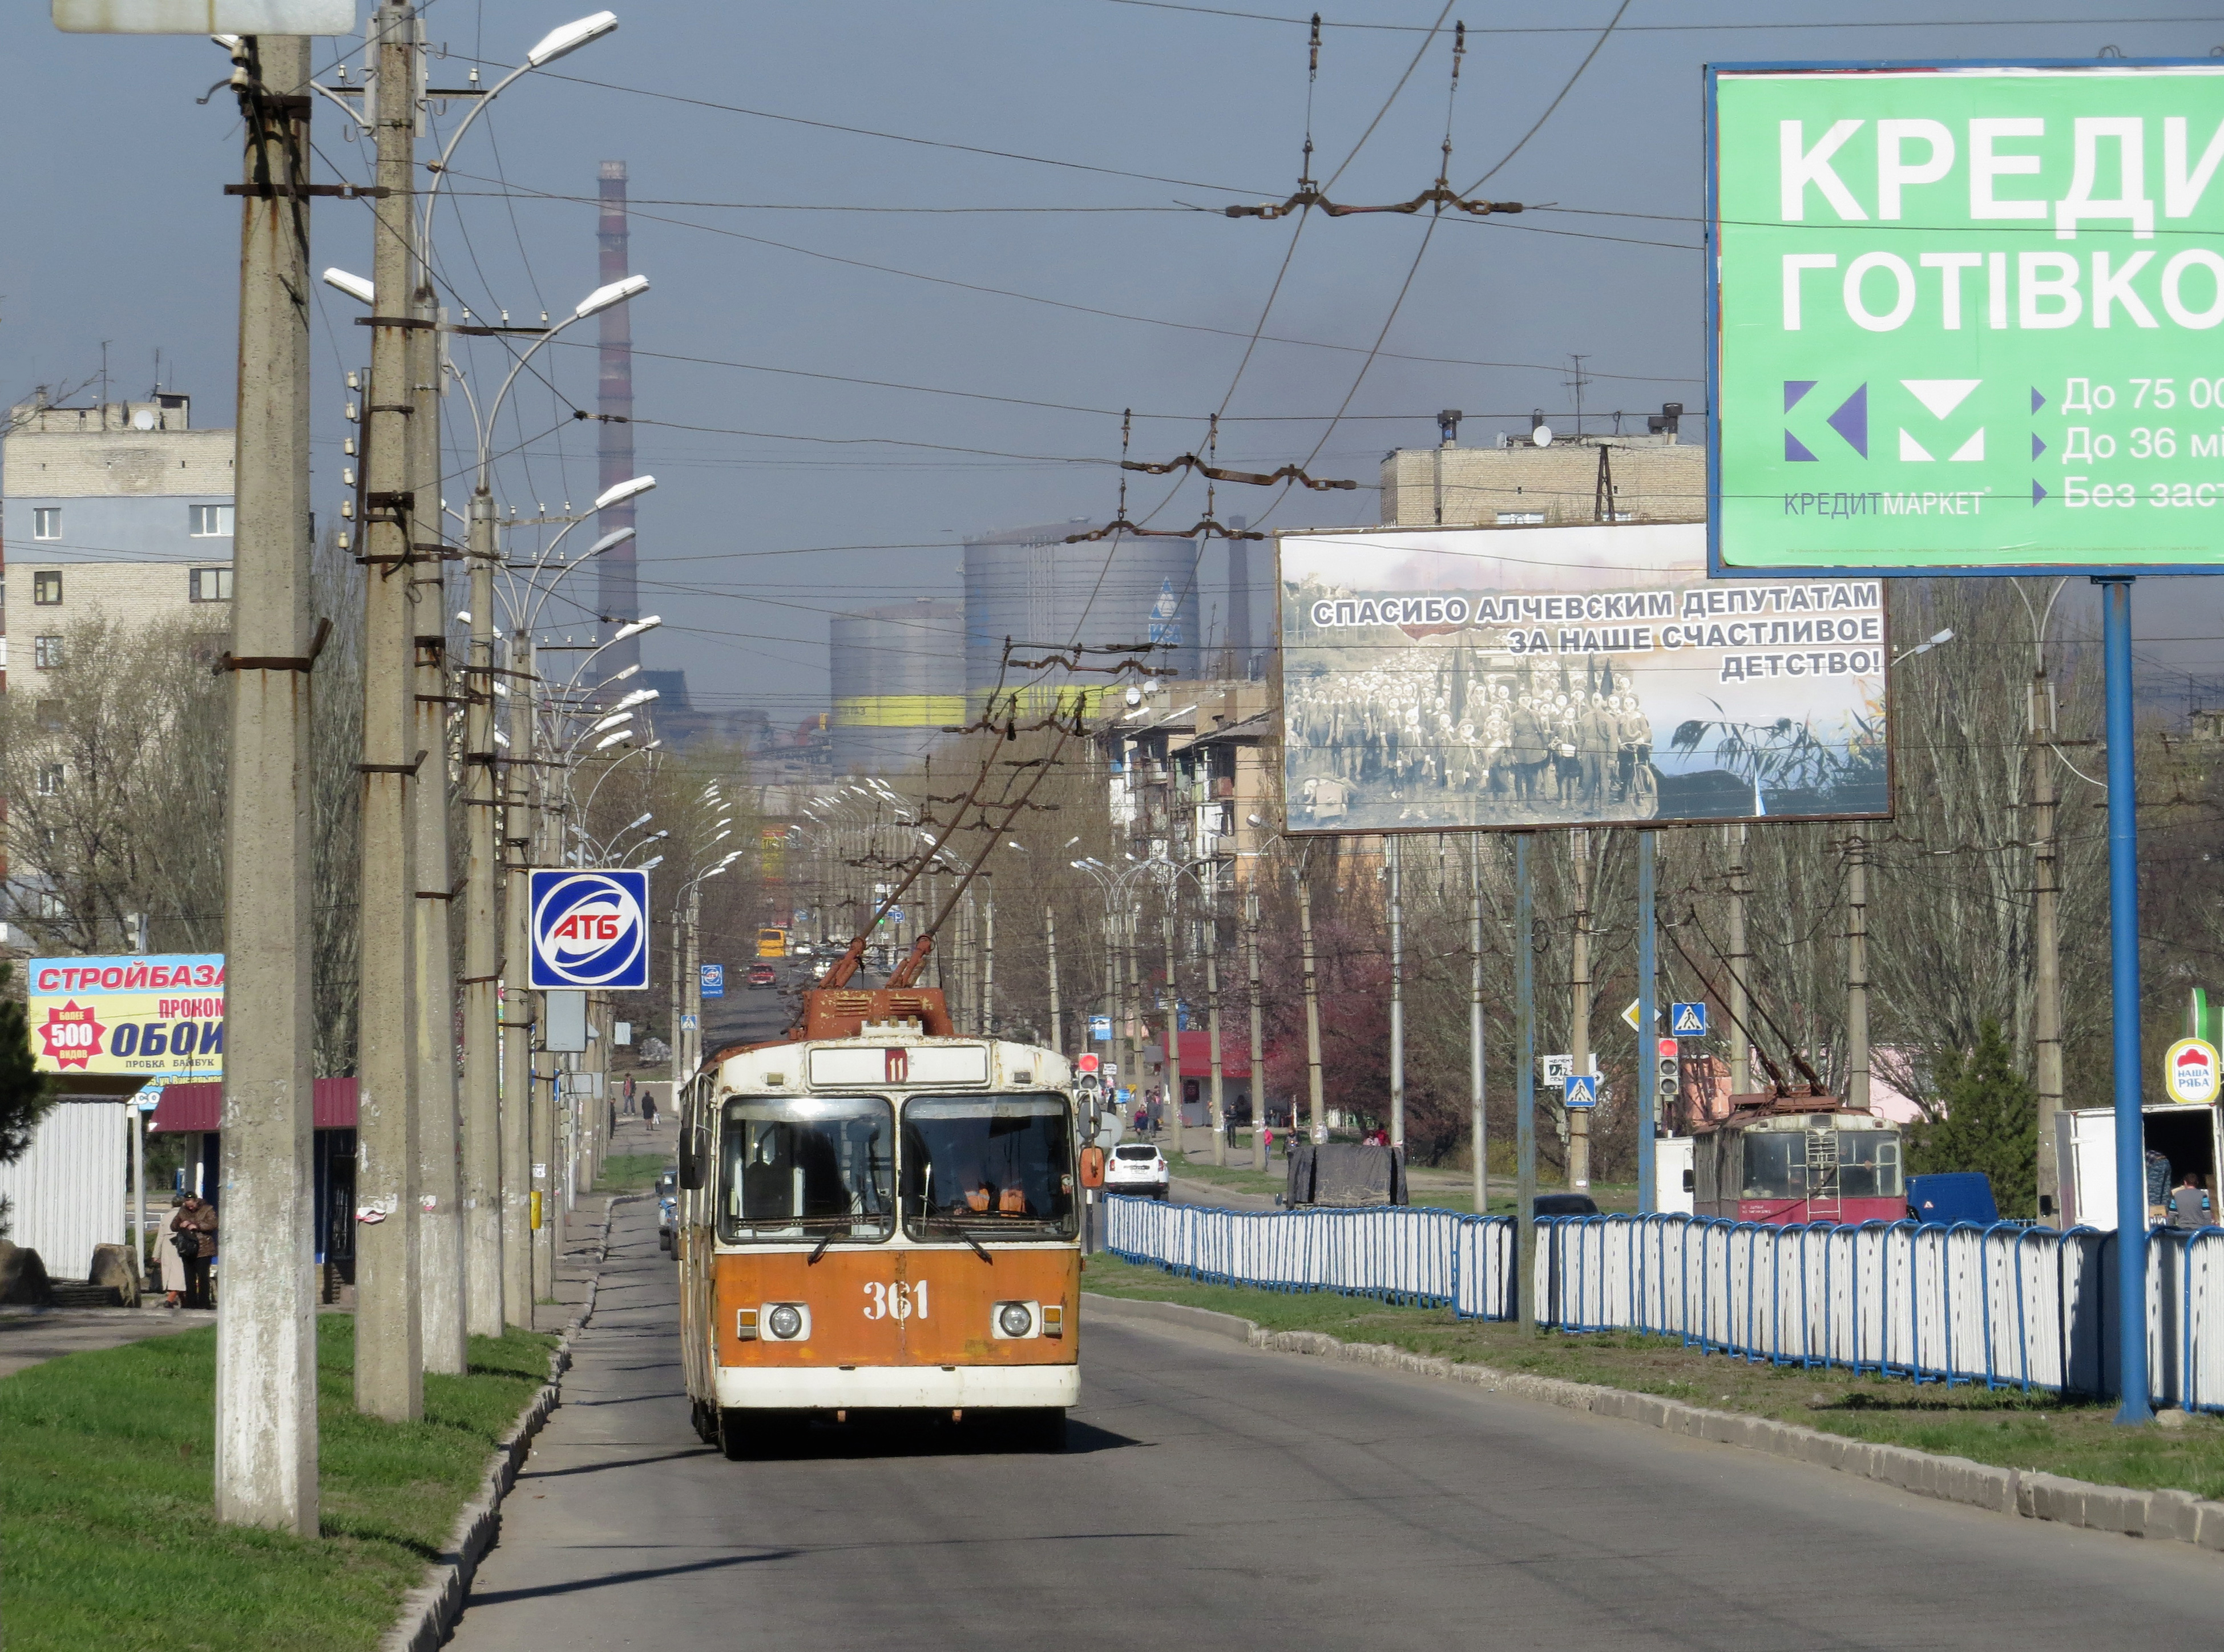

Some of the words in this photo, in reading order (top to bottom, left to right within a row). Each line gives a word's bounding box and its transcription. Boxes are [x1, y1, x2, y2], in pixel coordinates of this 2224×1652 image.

[1779, 116, 2224, 240] КРЕДИ
[1782, 248, 2224, 332] ГОТІВКО
[2061, 377, 2116, 415] До
[2129, 378, 2176, 410] 75
[2061, 427, 2116, 465] До
[2130, 427, 2177, 459] 36
[1784, 491, 1985, 520] КРЕДИТМАРКЕТ
[2064, 476, 2137, 508] Без
[1312, 598, 1468, 625] СПАСИБО
[1477, 594, 1672, 621] АЛЧЕВСКИМ
[1682, 584, 1878, 618] ДЕПУТАТАМ
[1508, 630, 1549, 654] ЗА
[1560, 628, 1652, 652] НАШЕ
[1662, 617, 1879, 648] СЧАСТЛИВОЕ
[1721, 650, 1880, 682] ДЕТСТВО!
[554, 915, 621, 940] АТБ
[59, 1011, 85, 1021] БОЛЕЕ
[51, 1023, 93, 1048] 500
[110, 1021, 224, 1057] ОБОИ
[59, 1049, 88, 1060] ВИДОВ
[889, 1057, 904, 1082] 11
[2178, 1069, 2210, 1078] НАША
[2178, 1077, 2210, 1088] РЯБА
[863, 1279, 929, 1320] 361
